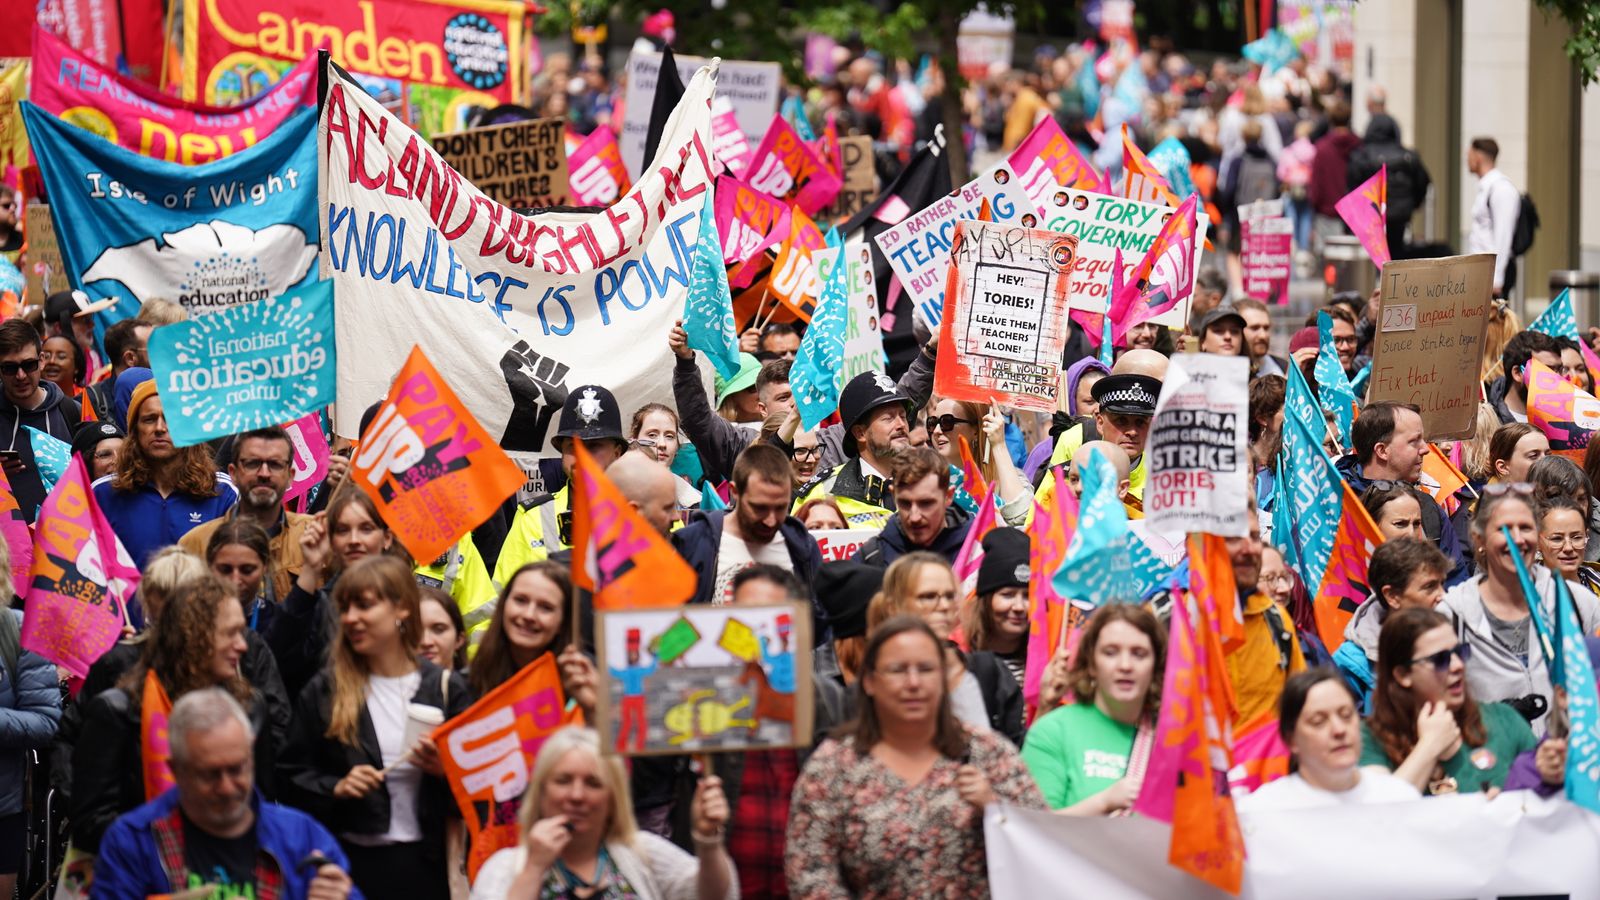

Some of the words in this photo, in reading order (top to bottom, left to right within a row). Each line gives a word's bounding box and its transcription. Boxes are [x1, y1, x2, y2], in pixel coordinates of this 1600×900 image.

[206, 0, 447, 84] Camden
[501, 120, 565, 149] CHEAT
[163, 187, 197, 208] of
[210, 167, 299, 206] Wight
[570, 155, 618, 205] UP
[750, 151, 793, 197] UP
[880, 231, 901, 250] I'D
[906, 198, 958, 236] RATHER
[962, 183, 984, 204] BE
[1096, 197, 1159, 228] TORY
[951, 225, 986, 270] PAY
[202, 273, 250, 287] national
[537, 284, 576, 336] IS
[594, 211, 704, 326] POWE
[773, 245, 818, 307] UP
[911, 268, 940, 295] BUT
[996, 273, 1025, 287] HEY!
[1387, 273, 1419, 300] I've
[1426, 273, 1467, 298] worked
[178, 287, 270, 307] education
[983, 291, 1035, 310] TORIES!
[976, 314, 1008, 328] LEAVE
[1010, 318, 1037, 331] THEM
[1383, 307, 1414, 329] 236
[1418, 302, 1456, 329] unpaid
[1461, 301, 1485, 318] hours
[980, 327, 1030, 342] TEACHERS
[984, 340, 1022, 354] ALONE!
[995, 361, 1009, 371] WE
[1016, 364, 1049, 376] WOULD
[1379, 366, 1402, 392] Fix
[1001, 381, 1018, 391] AT
[1023, 384, 1056, 398] WORK
[394, 370, 485, 466] PAY
[1222, 414, 1236, 430] A
[355, 402, 426, 487] UP
[1152, 444, 1236, 472] STRIKE
[1151, 490, 1197, 512] OUT!
[447, 705, 530, 803] UP
